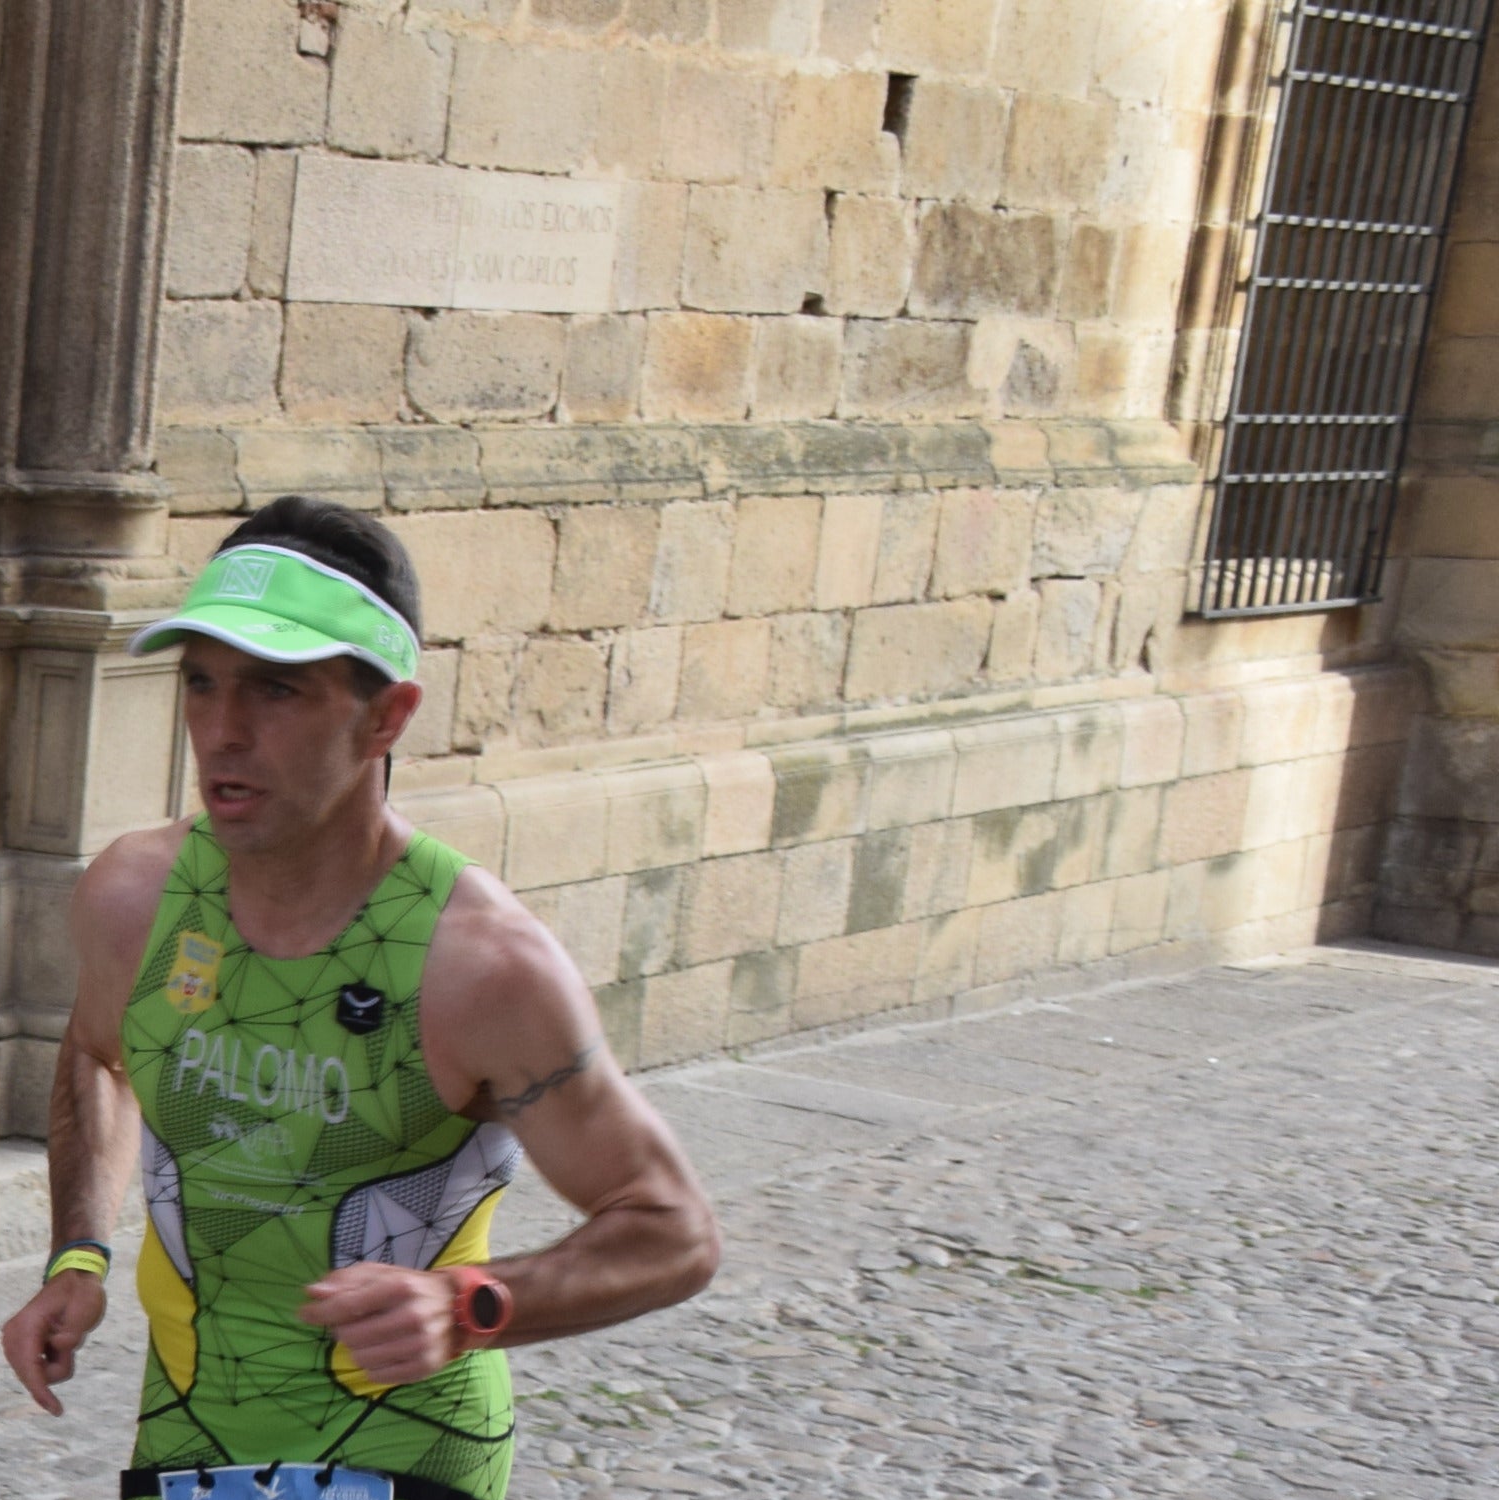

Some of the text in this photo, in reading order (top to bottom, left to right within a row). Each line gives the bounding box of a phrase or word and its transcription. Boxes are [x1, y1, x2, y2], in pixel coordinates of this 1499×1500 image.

[470, 252, 504, 283] SAN
[510, 253, 579, 287] CARLOS
[174, 1028, 351, 1125] PALOMO
